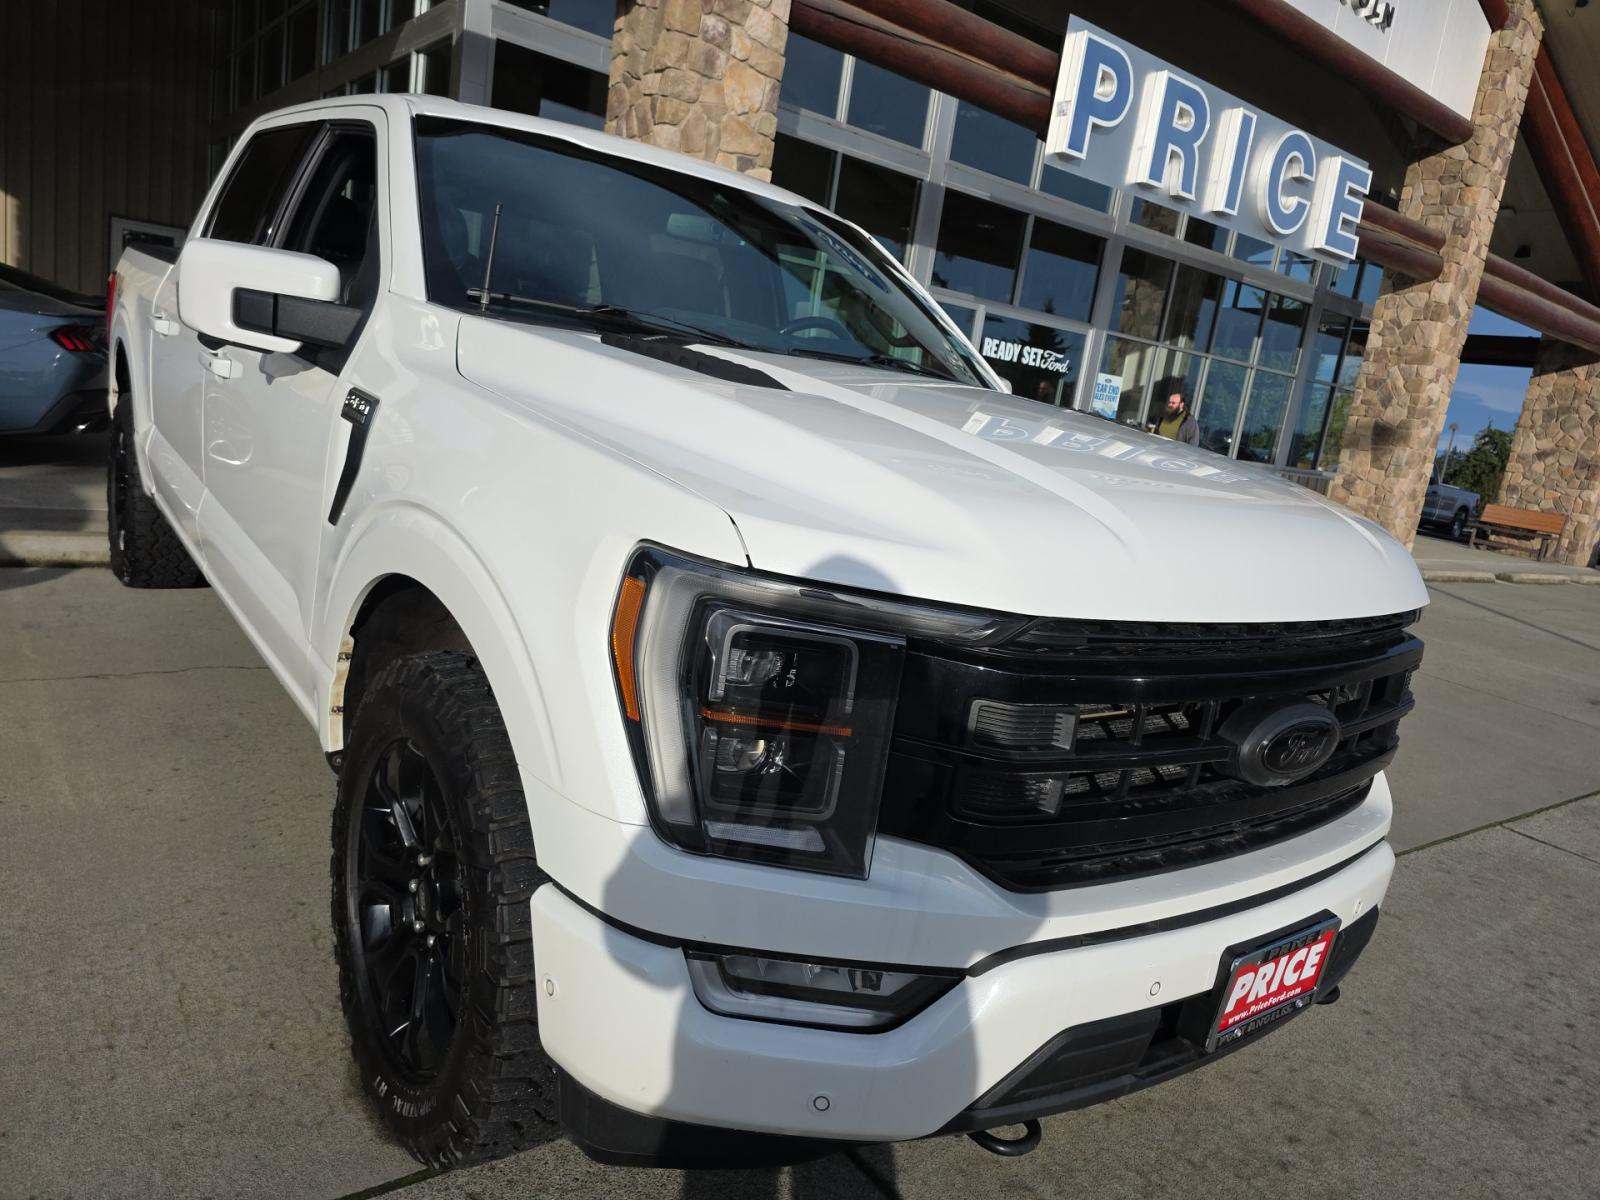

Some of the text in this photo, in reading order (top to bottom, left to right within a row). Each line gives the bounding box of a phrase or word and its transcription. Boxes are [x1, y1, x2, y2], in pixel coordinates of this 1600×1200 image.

[1046, 30, 1373, 259] PRICE
[983, 337, 1022, 363] READY
[1020, 346, 1044, 367] SET
[1224, 941, 1327, 1014] PRICE
[1228, 987, 1302, 1024] www.PriceFord.com
